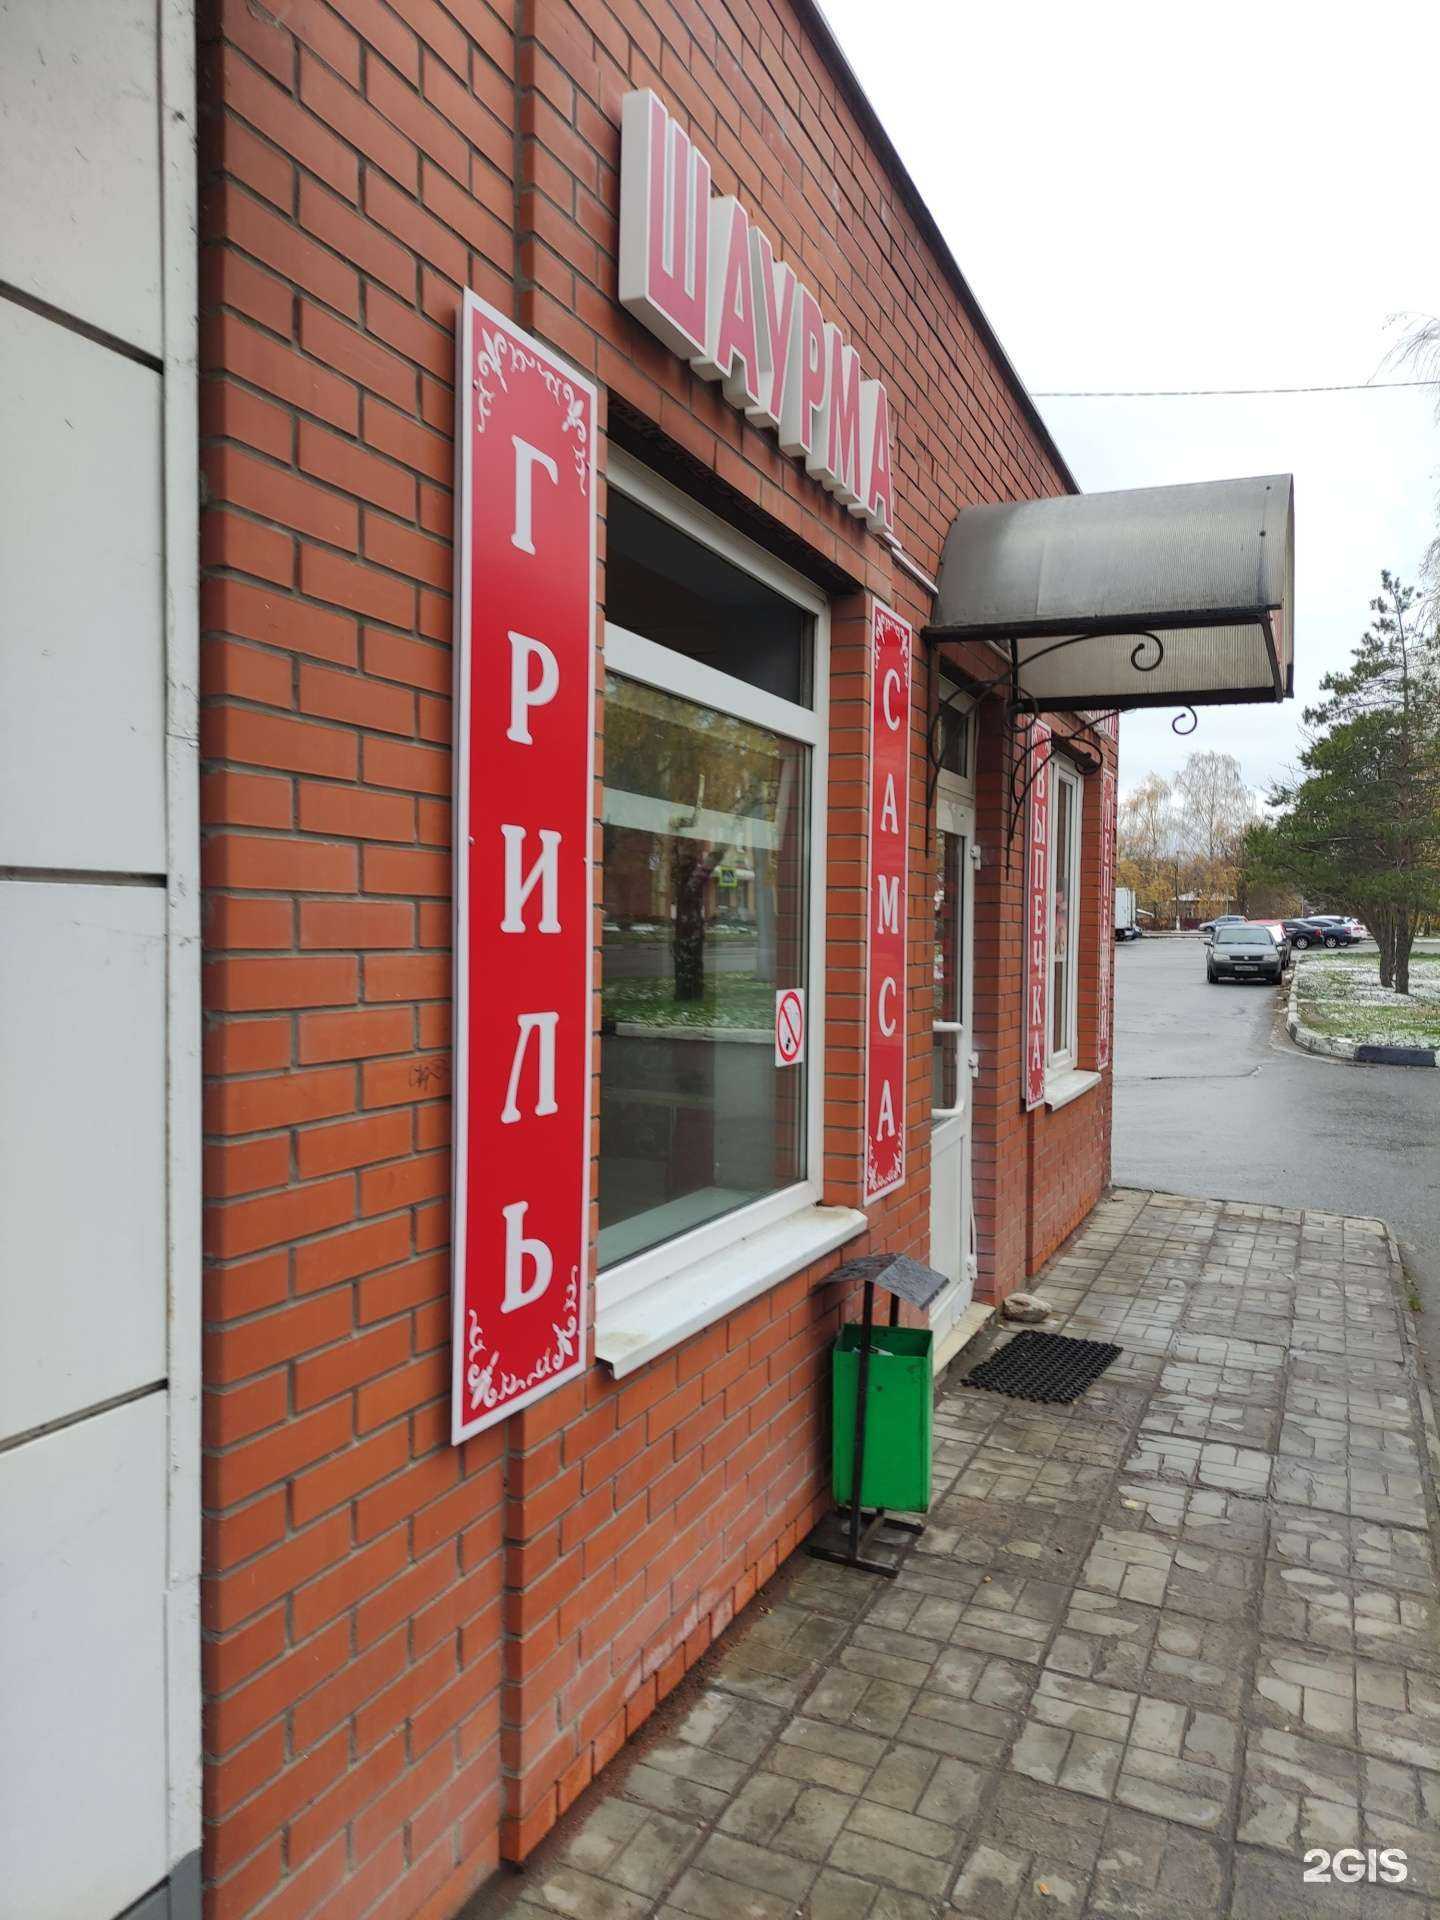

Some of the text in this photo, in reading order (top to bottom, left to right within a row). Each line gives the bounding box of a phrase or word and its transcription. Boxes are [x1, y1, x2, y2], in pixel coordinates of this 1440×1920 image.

[646, 88, 893, 533] ШАУРМА
[500, 434, 562, 1315] ГРИЛЬ
[876, 668, 901, 1142] САМСА
[1031, 756, 1046, 1072] ВЫПЕЧКА
